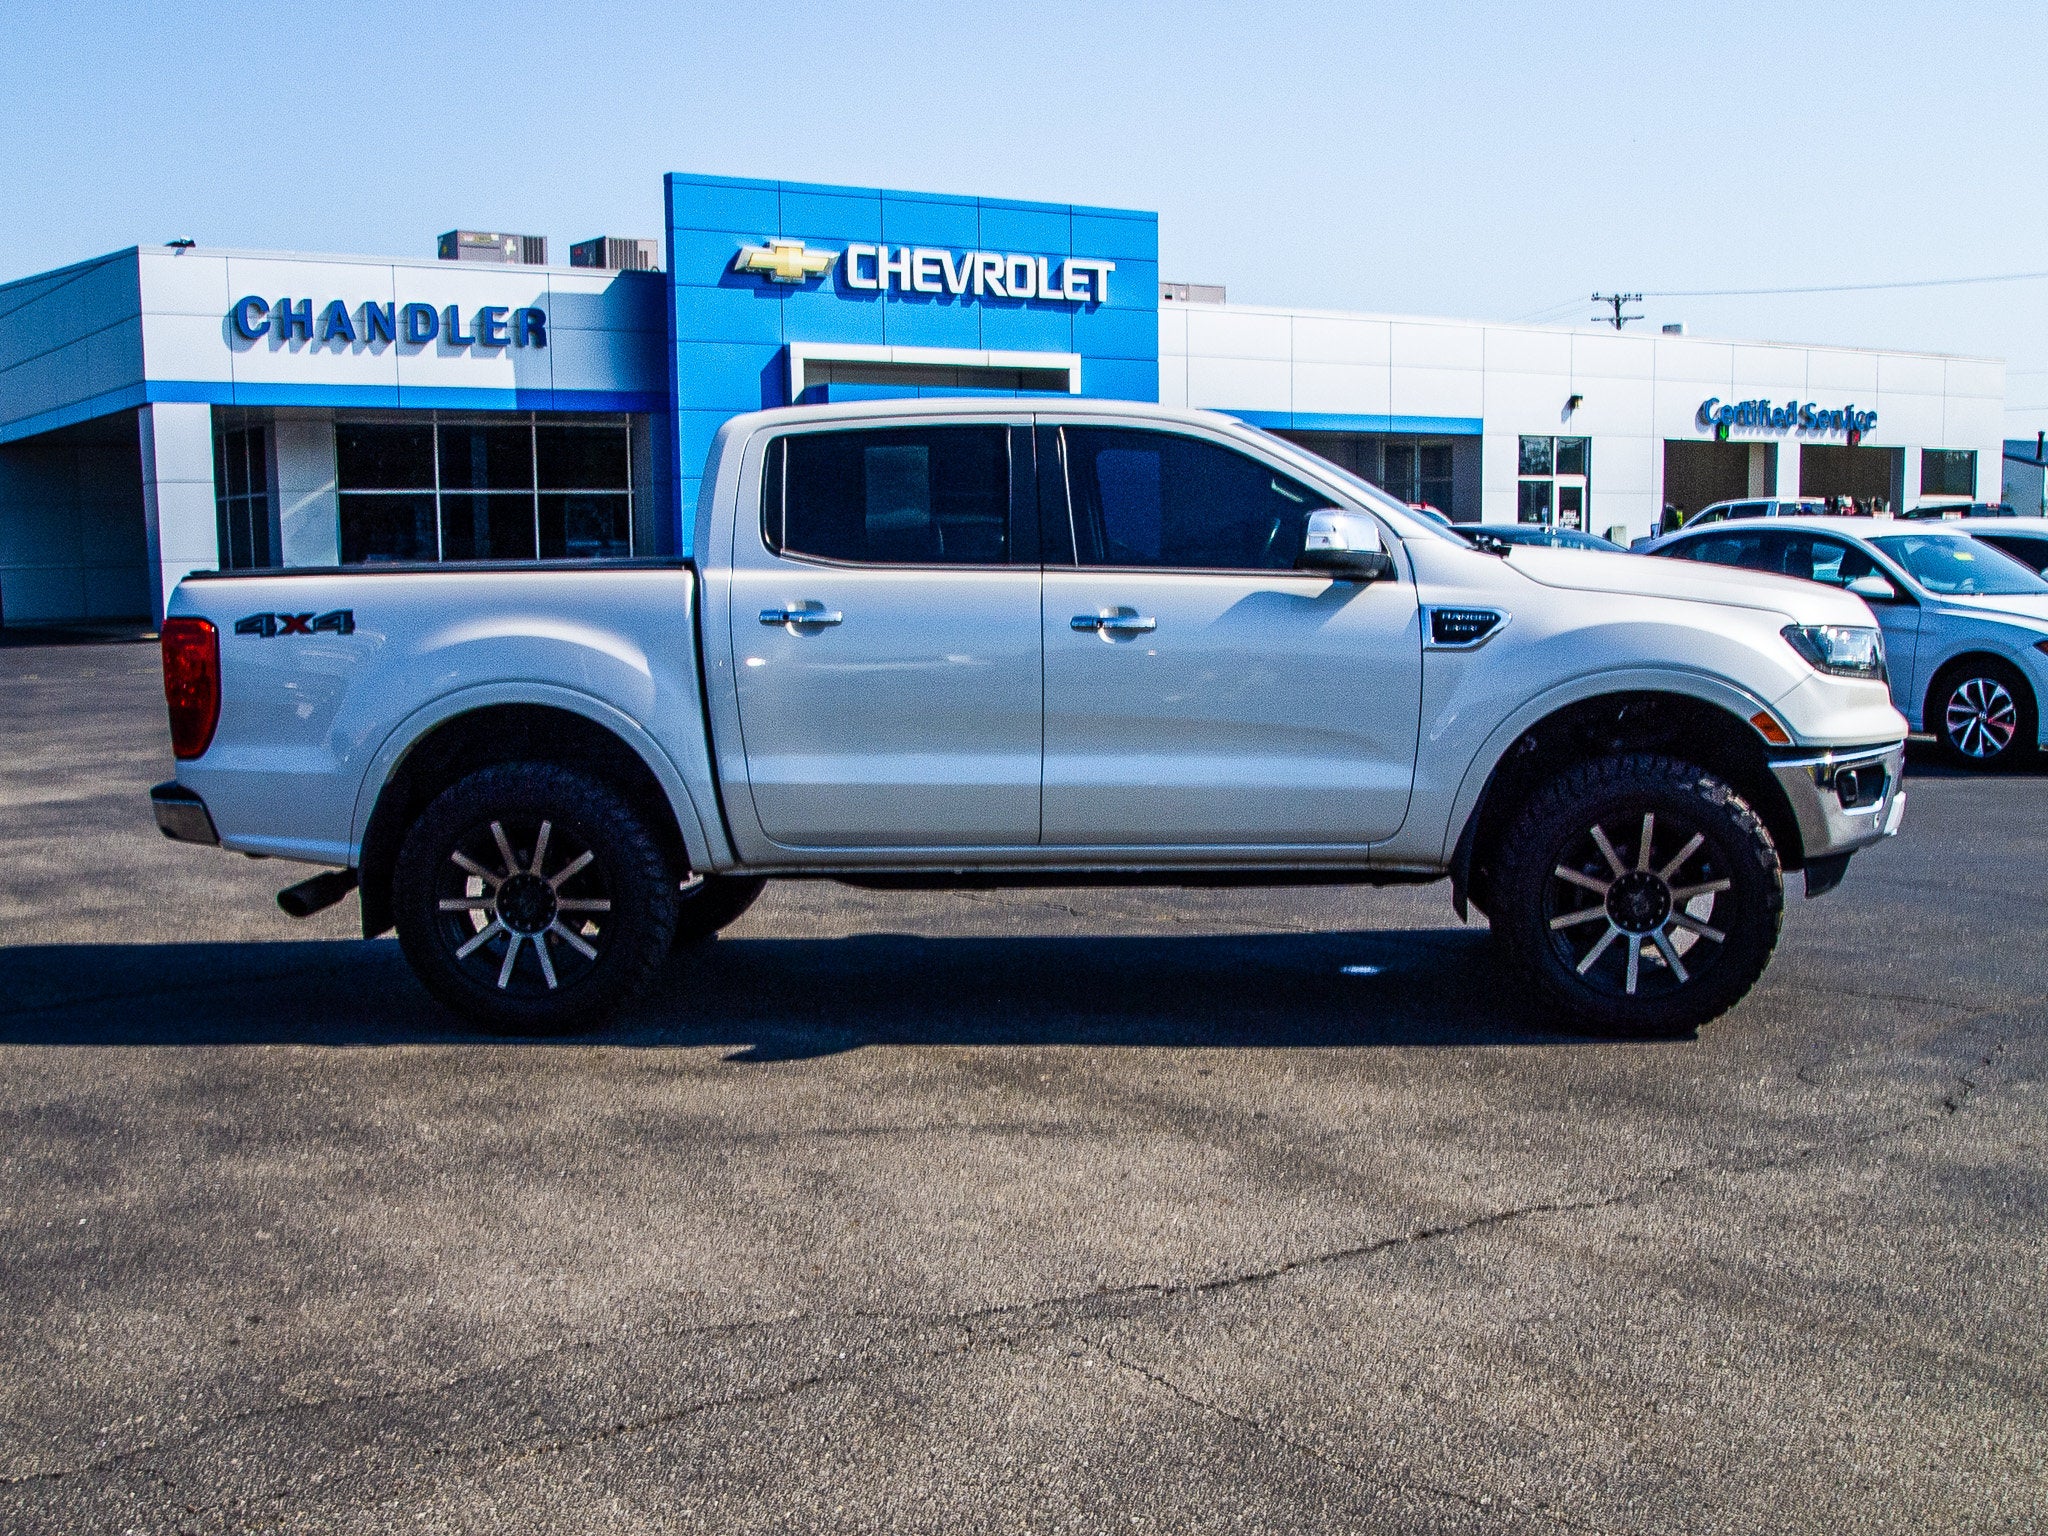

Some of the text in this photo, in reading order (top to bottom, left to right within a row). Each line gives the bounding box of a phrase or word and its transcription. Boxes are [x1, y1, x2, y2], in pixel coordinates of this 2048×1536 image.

[846, 243, 1116, 304] CHEVROLET
[235, 295, 547, 348] CHANDLER
[1704, 397, 1878, 431] Certified Service
